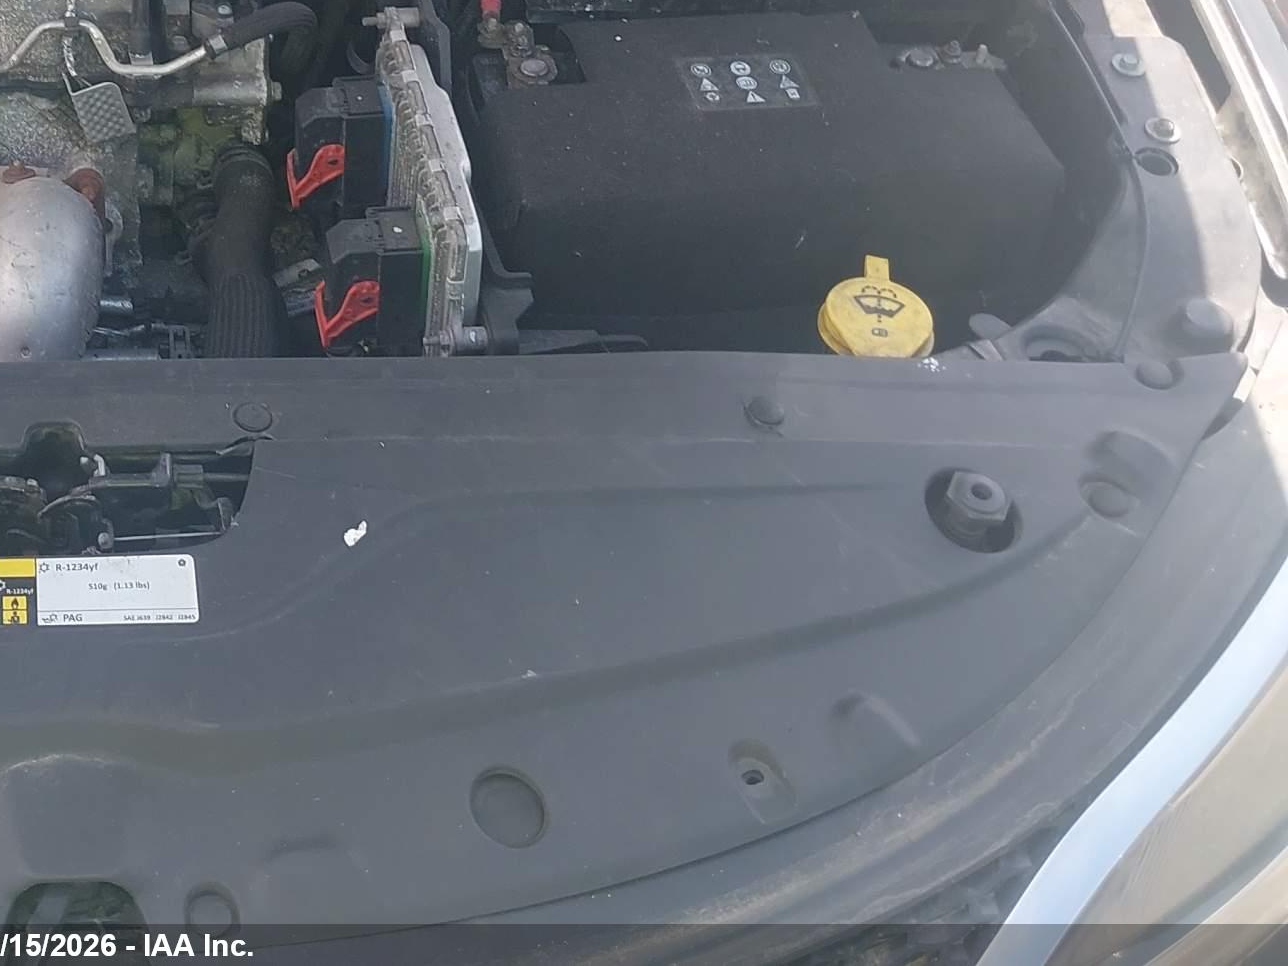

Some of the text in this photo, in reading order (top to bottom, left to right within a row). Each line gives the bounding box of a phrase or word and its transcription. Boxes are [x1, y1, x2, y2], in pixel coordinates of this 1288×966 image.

[56, 563, 99, 573] R-1234yf
[88, 580, 150, 591] 510g (1.13 lbs)
[63, 613, 83, 622] PAG
